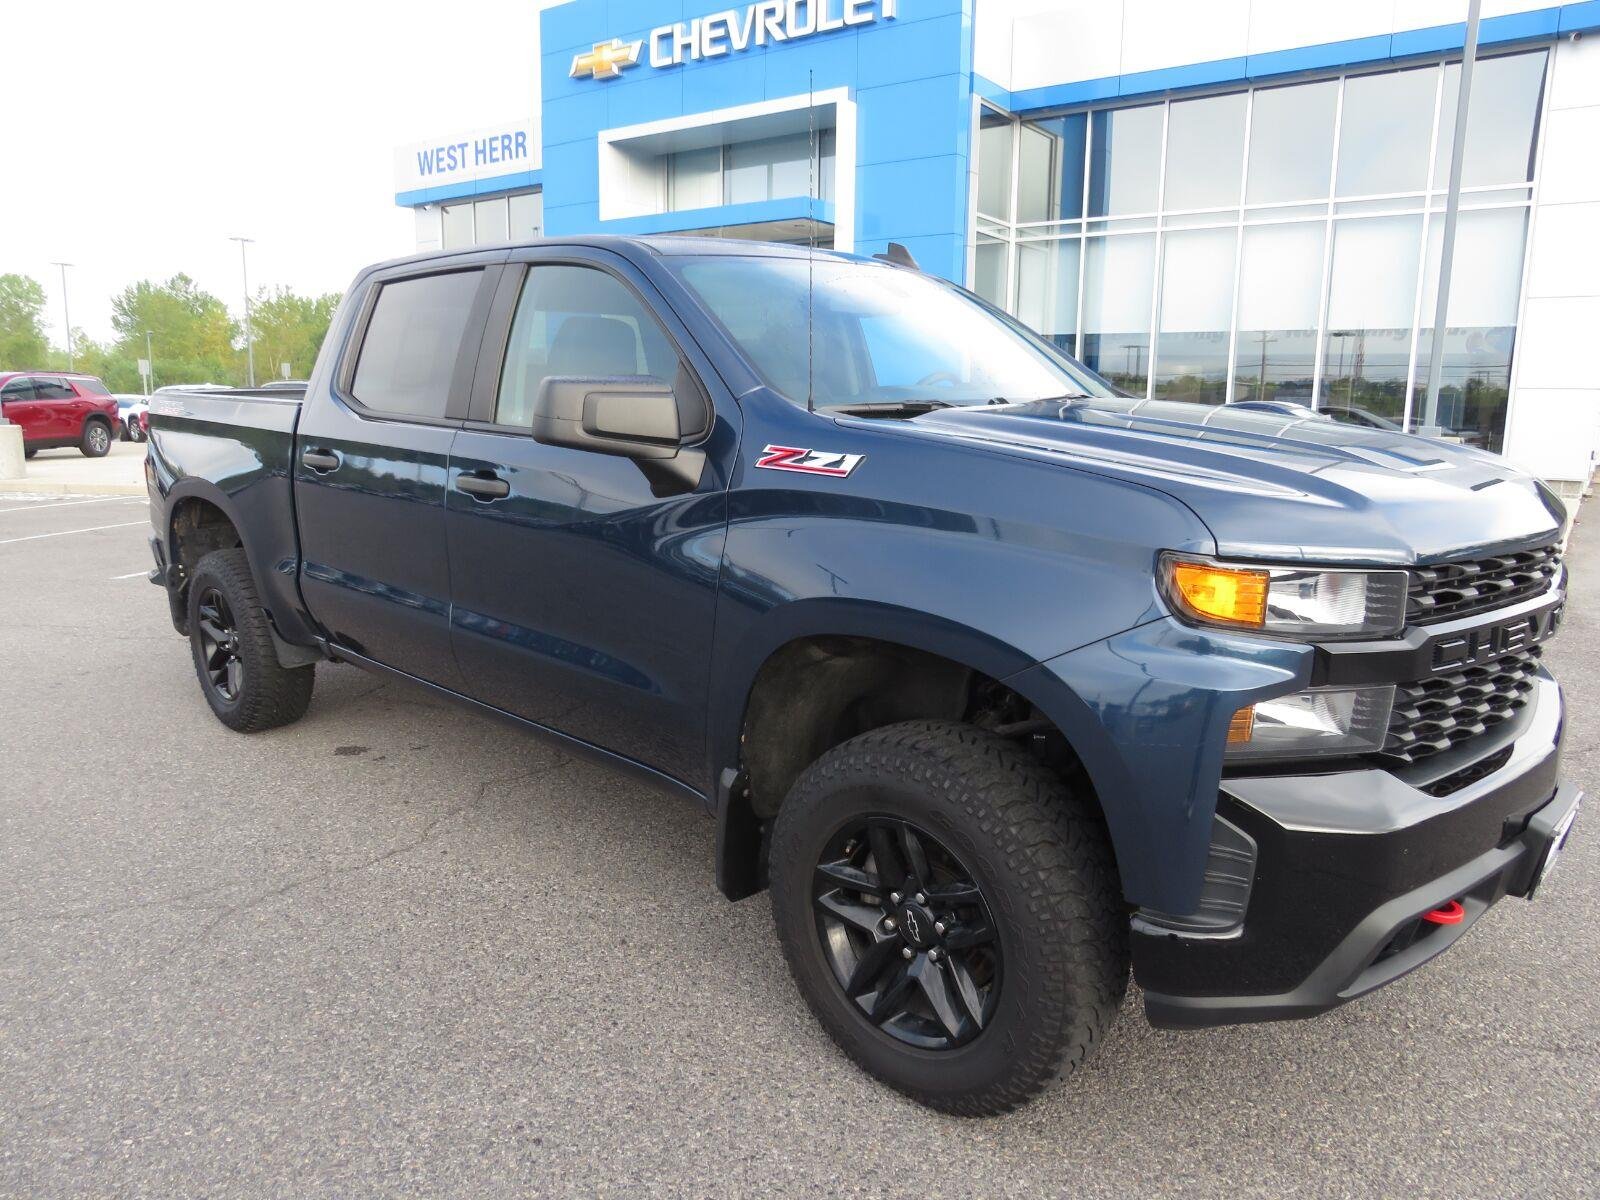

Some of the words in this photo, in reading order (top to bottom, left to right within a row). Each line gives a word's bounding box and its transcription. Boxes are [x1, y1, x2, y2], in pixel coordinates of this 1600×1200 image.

[417, 142, 469, 176] WEST
[475, 131, 527, 166] HERR
[754, 443, 866, 479] Z71
